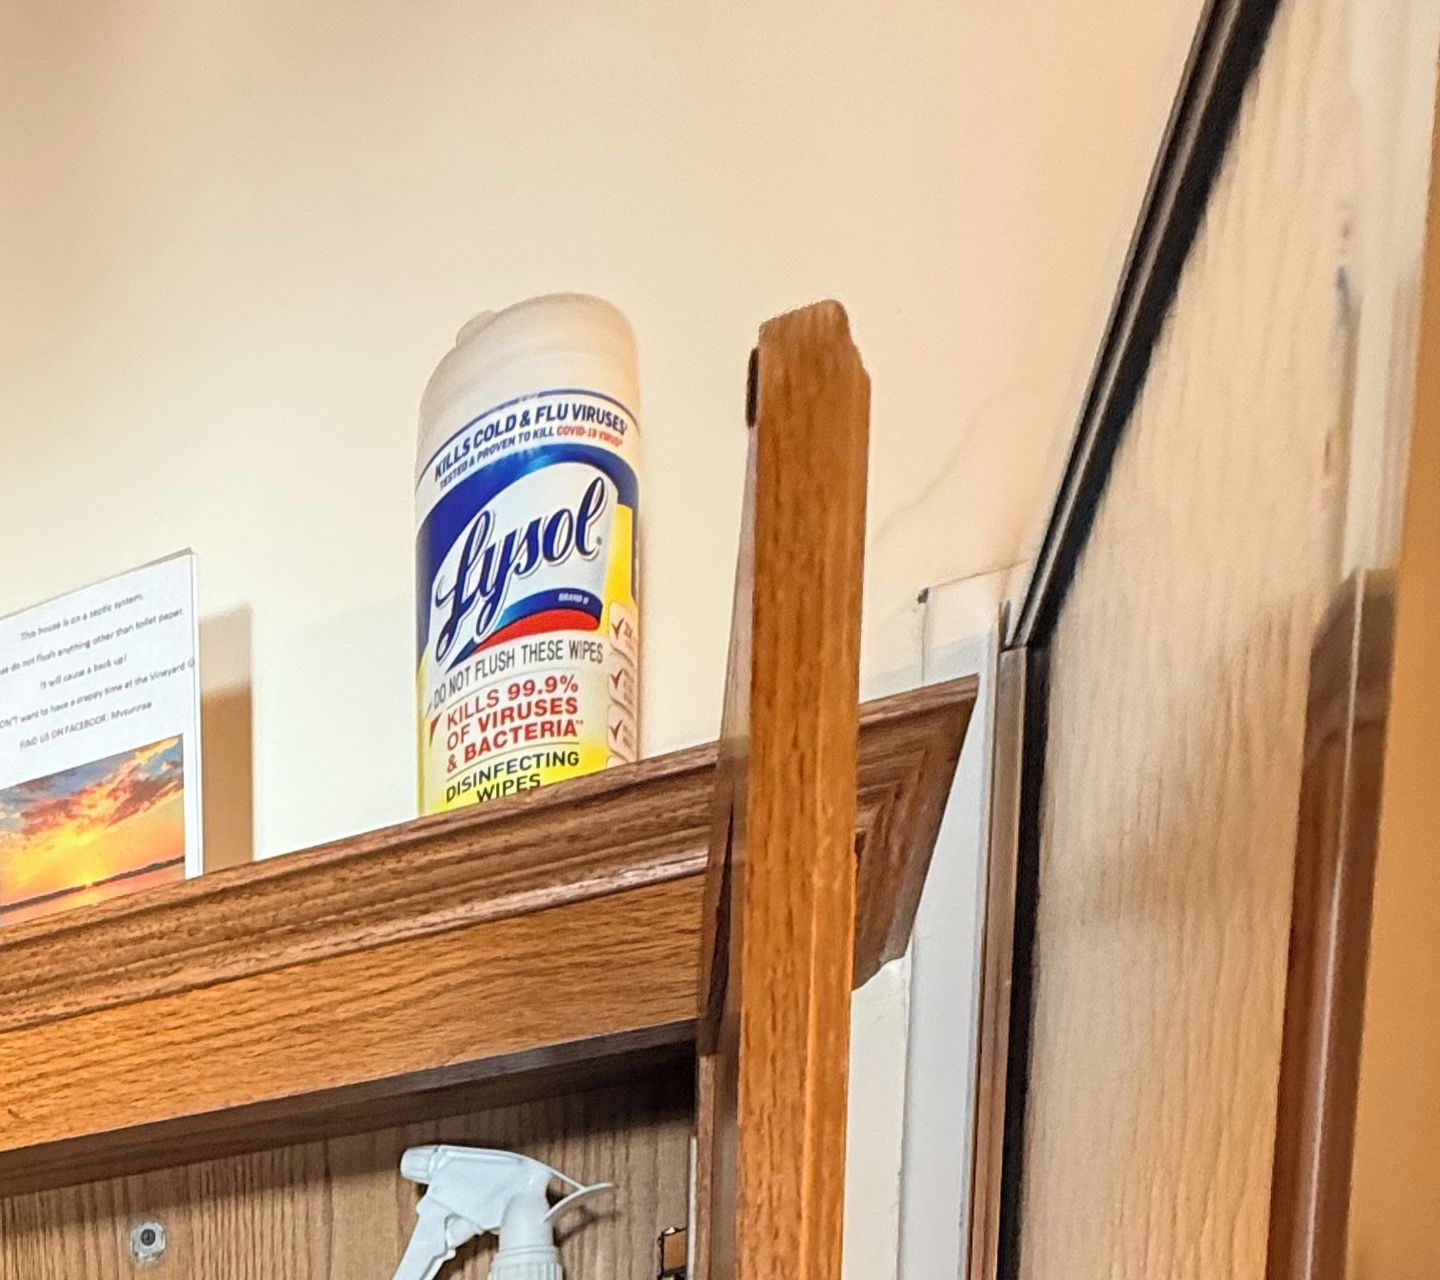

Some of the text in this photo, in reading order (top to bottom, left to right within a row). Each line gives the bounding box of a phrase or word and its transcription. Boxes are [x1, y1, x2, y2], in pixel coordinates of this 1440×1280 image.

[434, 438, 472, 482] KILLS
[474, 410, 517, 448] COLD
[519, 410, 530, 428] &
[535, 404, 568, 424] FLU
[440, 464, 467, 488] TESTED
[477, 436, 515, 459] PROVEN
[518, 431, 530, 443] TO
[533, 426, 554, 438] KILL
[435, 476, 605, 663] Lysol
[11, 661, 20, 671] do
[22, 657, 35, 668] not
[36, 651, 55, 663] flush
[58, 640, 91, 657] anything
[92, 634, 113, 646] other
[116, 625, 134, 637] than
[136, 616, 156, 630] toilet
[159, 608, 184, 623] paper.
[21, 630, 36, 640] This
[38, 623, 60, 635] house
[63, 618, 69, 626] is
[71, 615, 81, 625] on
[83, 612, 87, 621] a
[90, 604, 112, 620] septic
[21, 710, 39, 723] want
[40, 707, 49, 716] to
[50, 702, 68, 713] have
[70, 698, 75, 707] a
[77, 689, 103, 705] crappy
[104, 684, 122, 695] time
[125, 681, 132, 690] at
[134, 675, 148, 686] the
[150, 661, 185, 681] Vineyard
[49, 675, 61, 686] will
[63, 668, 85, 681] cause
[87, 667, 92, 675] a
[94, 660, 111, 671] back
[113, 653, 127, 668] up!
[433, 640, 603, 708] DO NOT FLUSH THESE WIPES
[447, 674, 578, 731] KILLS 99.9%
[447, 697, 578, 750] OF VIRUSES
[19, 736, 37, 749] FIND
[40, 732, 50, 742] US
[51, 727, 63, 737] ON
[447, 757, 457, 774] &
[447, 751, 579, 804] DISINFECTING
[476, 773, 540, 803] WIPES
